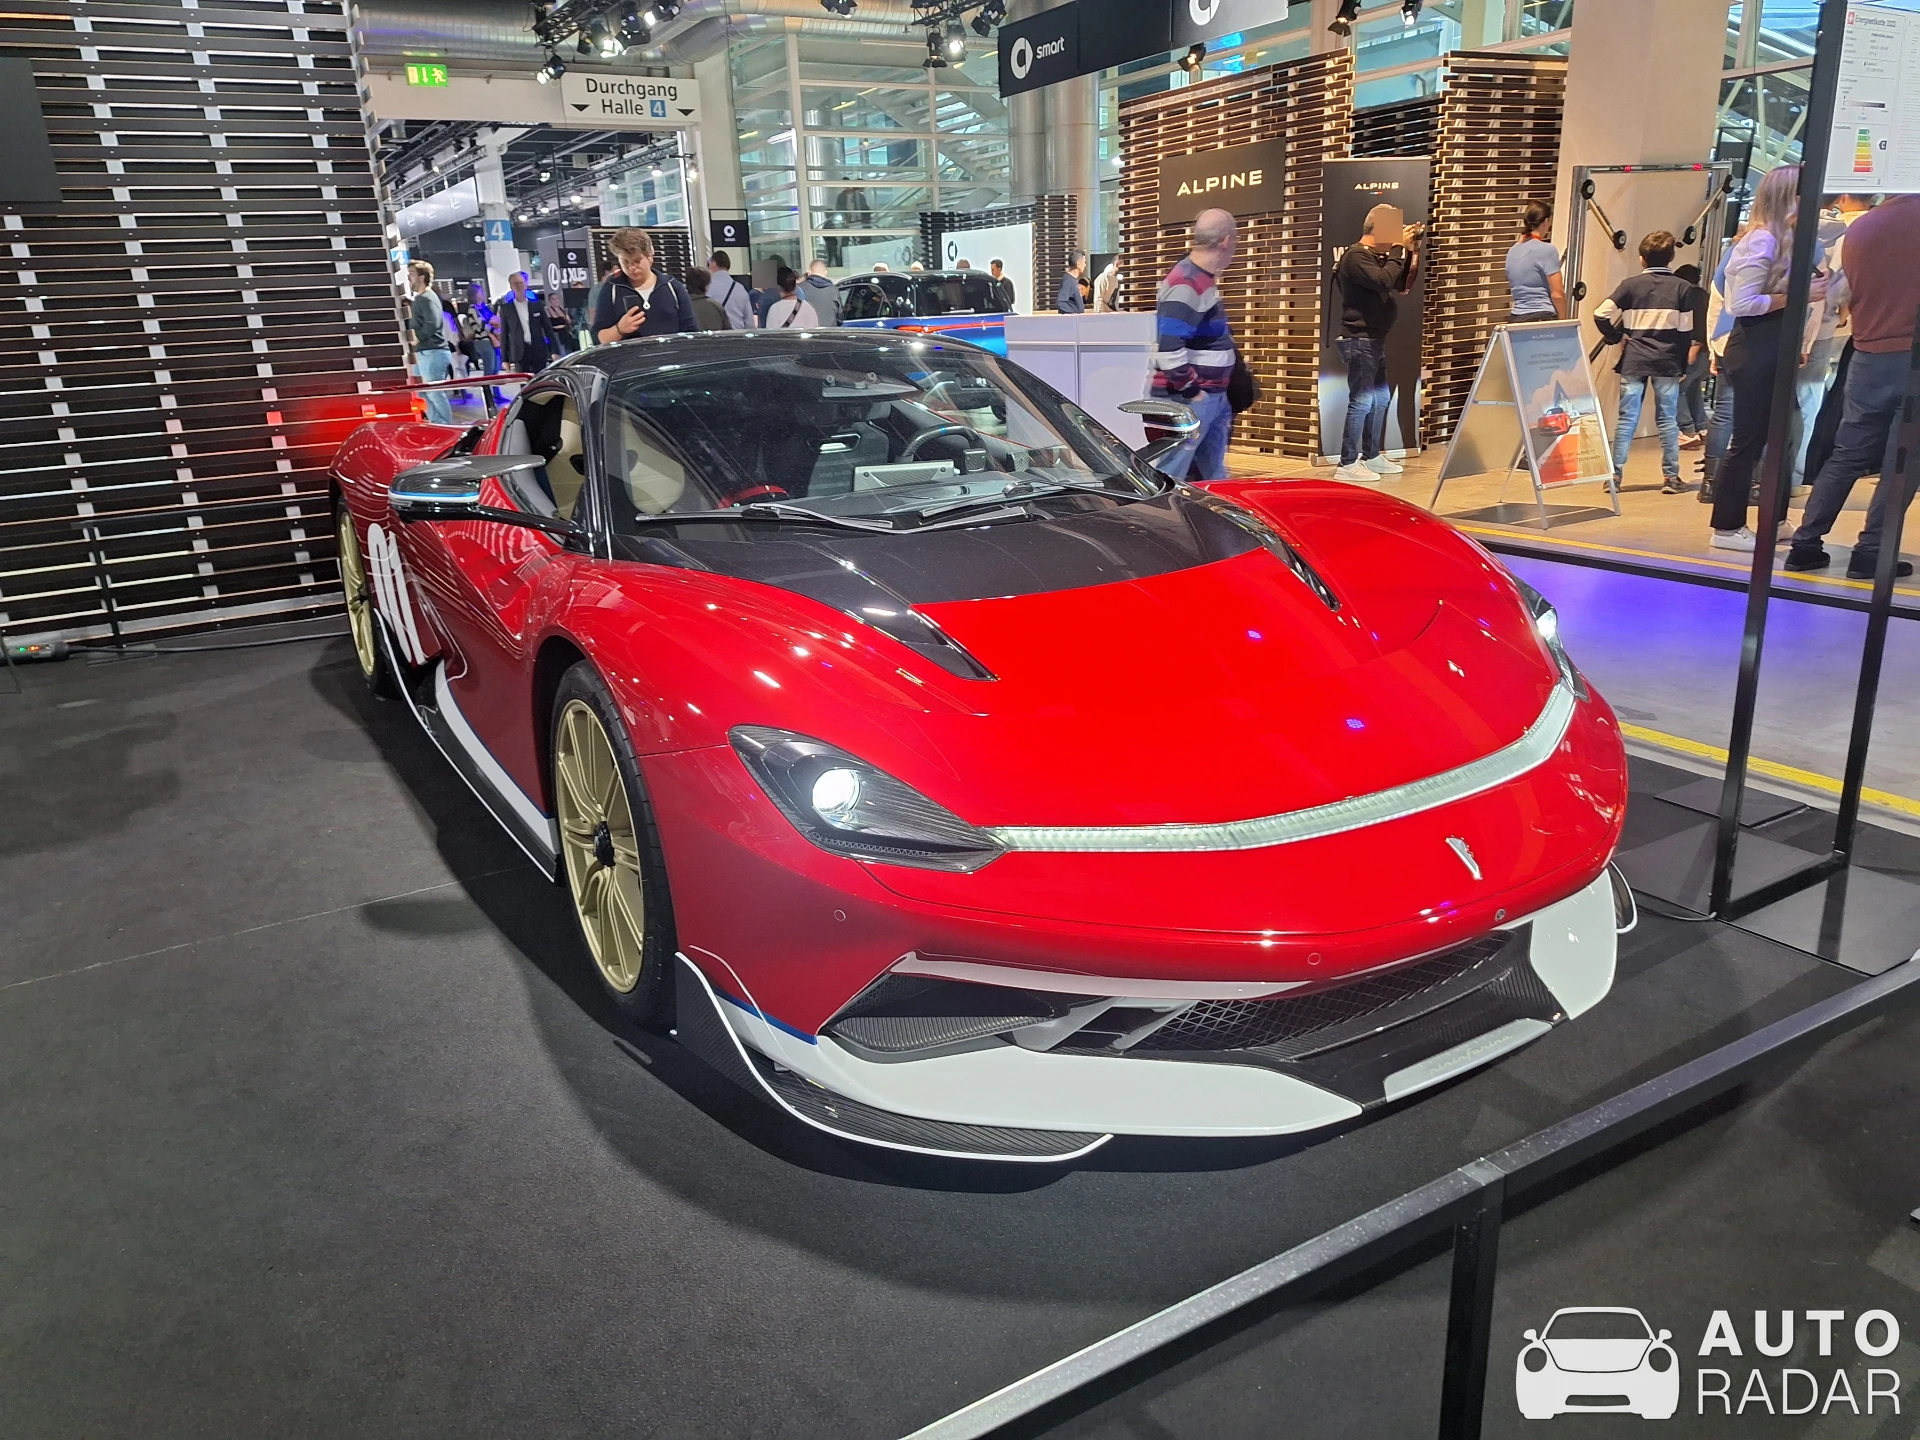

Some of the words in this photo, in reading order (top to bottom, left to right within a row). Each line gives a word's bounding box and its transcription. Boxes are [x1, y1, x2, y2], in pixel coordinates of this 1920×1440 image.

[1036, 36, 1065, 59] smart
[586, 78, 678, 101] Durchgang
[601, 99, 644, 115] Halle
[652, 101, 664, 117] 4
[1176, 169, 1263, 196] ALPINE
[1354, 182, 1399, 190] ALPINE
[491, 221, 505, 241] 4
